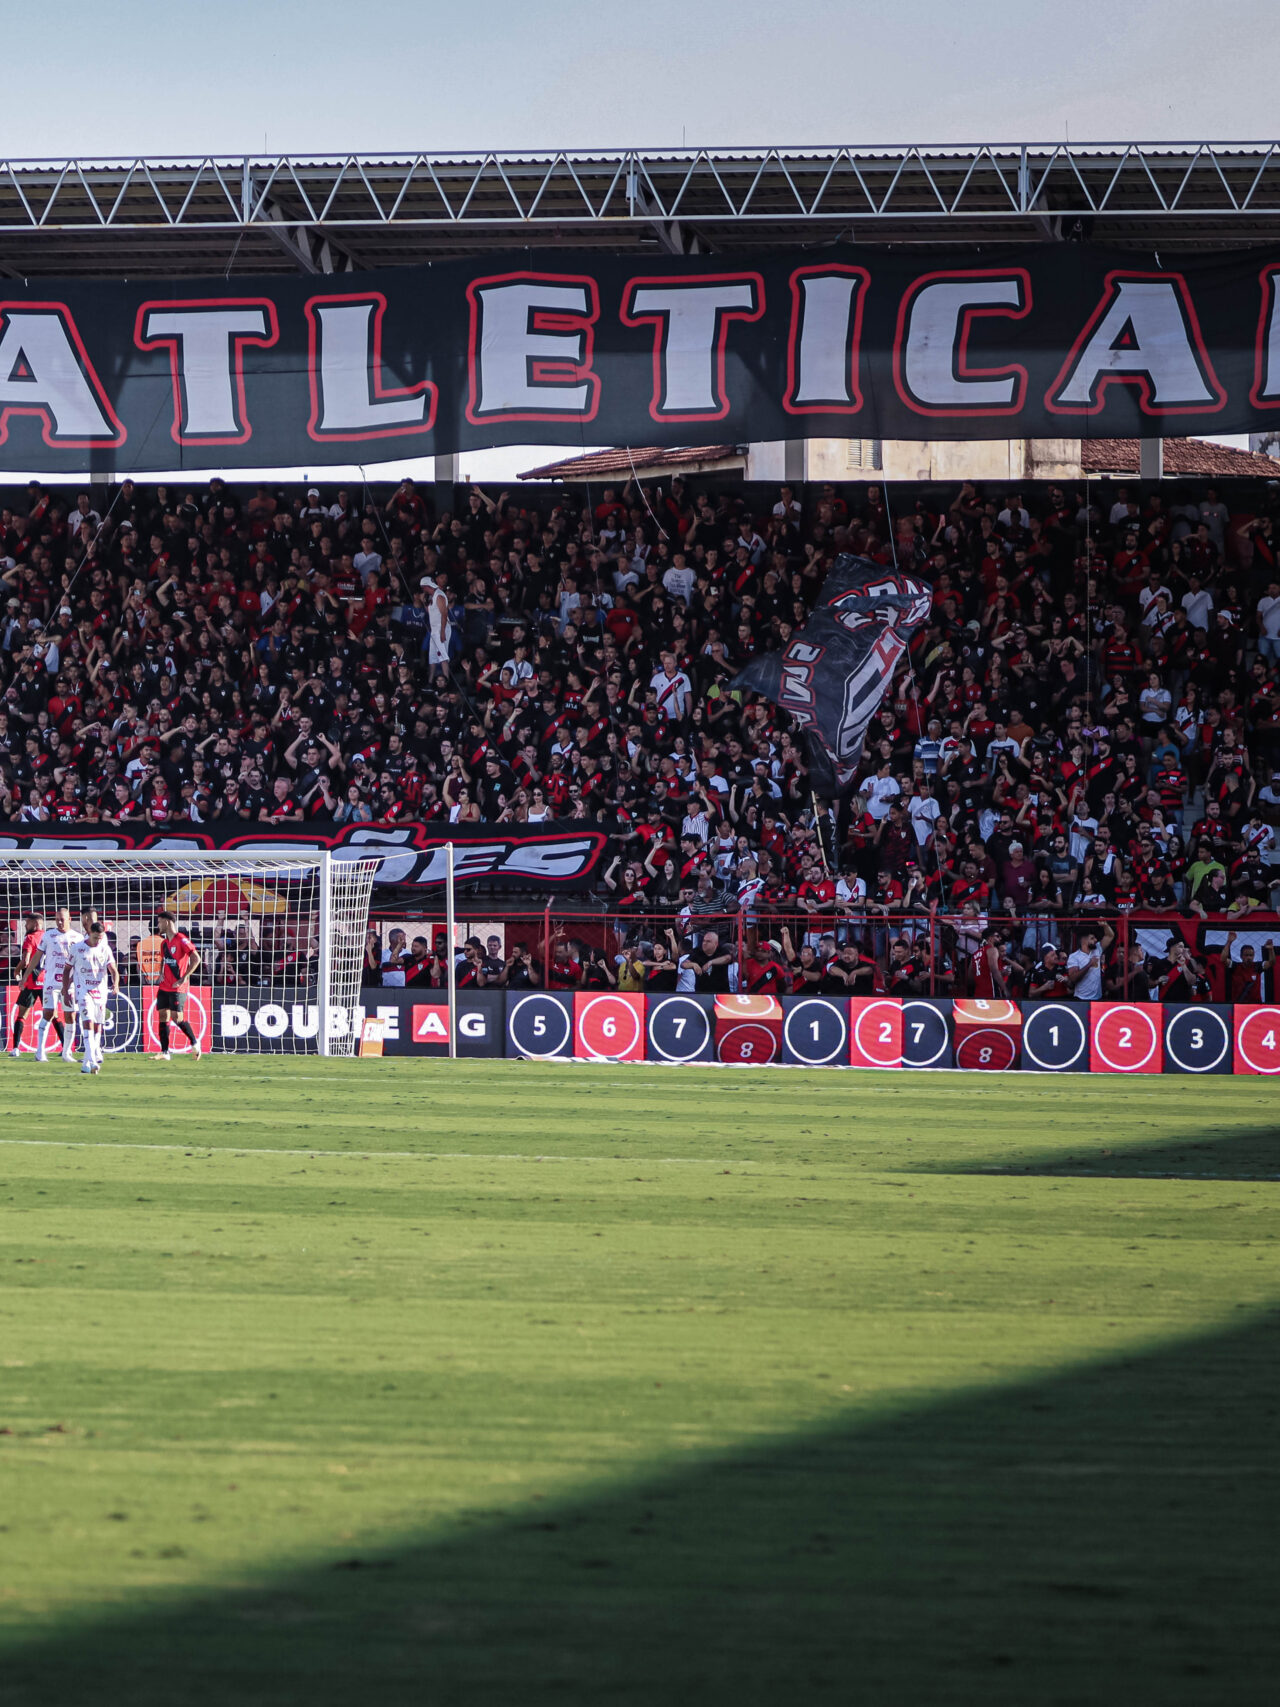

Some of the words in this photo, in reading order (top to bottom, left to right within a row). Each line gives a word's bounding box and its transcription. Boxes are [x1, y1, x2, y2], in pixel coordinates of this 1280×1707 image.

[533, 1016, 547, 1036] 5
[602, 1017, 616, 1037] 6
[672, 1018, 687, 1038] 7
[740, 1042, 754, 1058] 8
[809, 1021, 820, 1041] 1
[878, 1023, 892, 1043] 2
[911, 1023, 926, 1043] 7
[979, 1047, 992, 1063] 8
[1048, 1027, 1059, 1046] 1
[1118, 1028, 1132, 1048] 2
[1190, 1029, 1204, 1049] 3
[1261, 1030, 1277, 1050] 4
